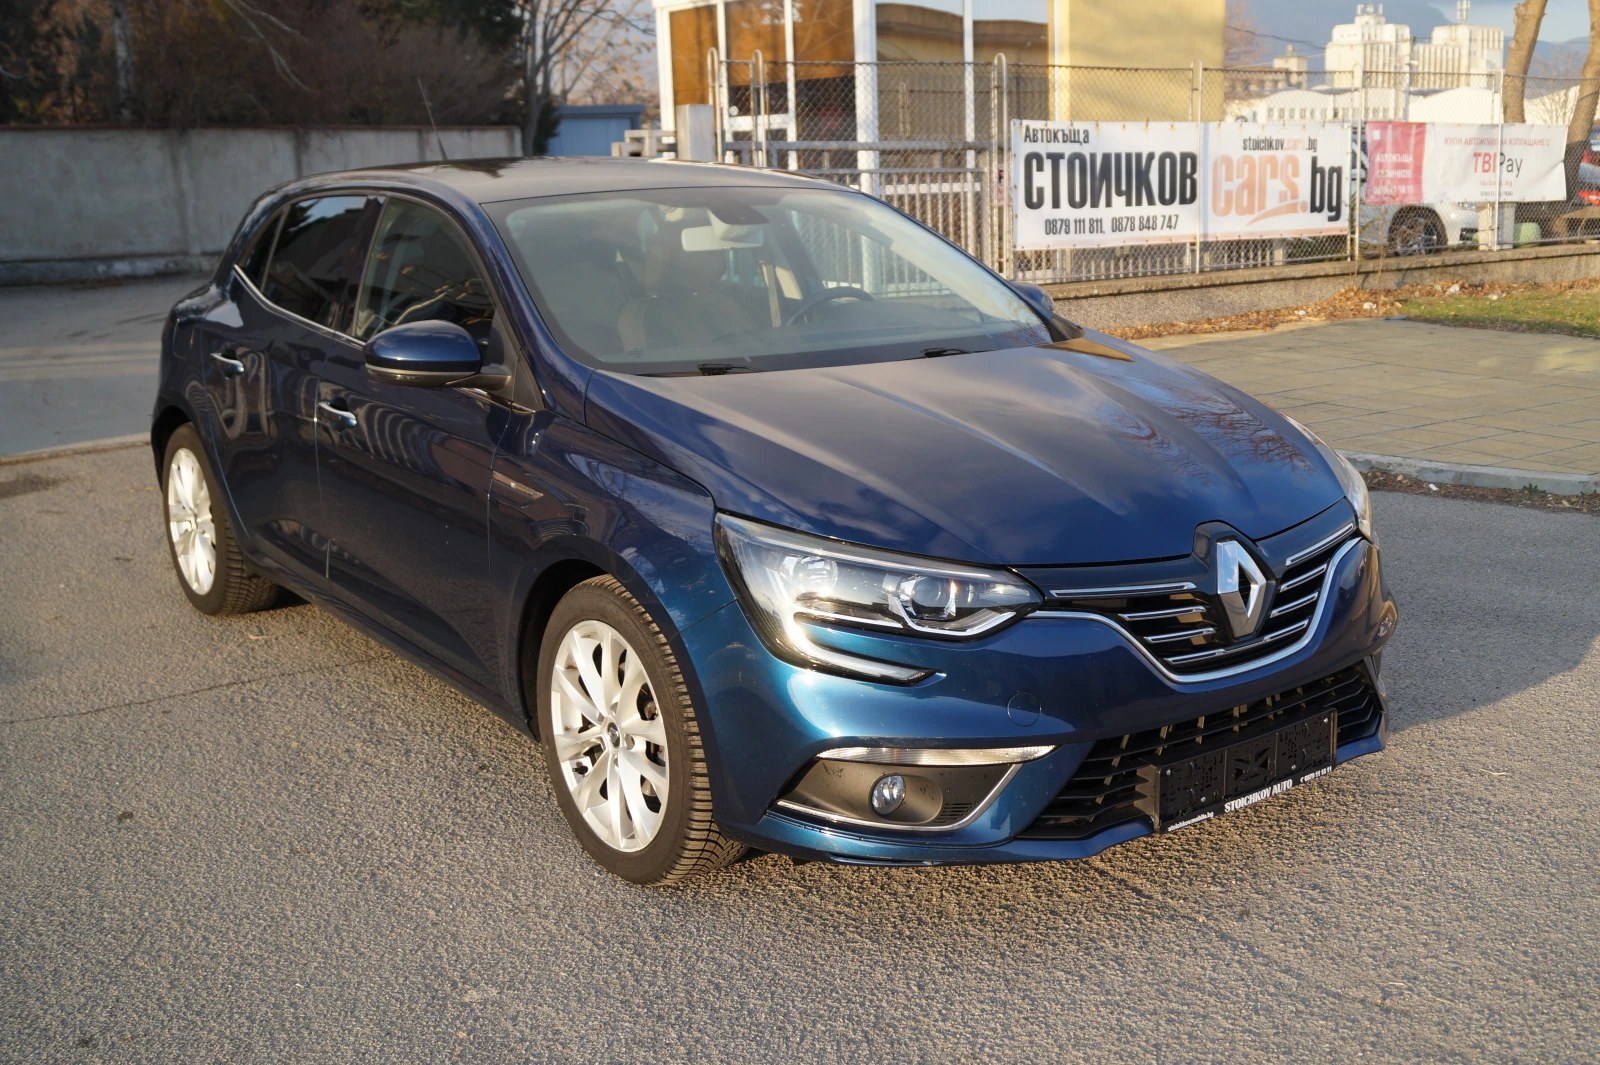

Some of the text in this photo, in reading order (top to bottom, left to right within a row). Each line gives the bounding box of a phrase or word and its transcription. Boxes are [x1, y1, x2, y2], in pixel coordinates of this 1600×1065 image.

[1444, 136, 1463, 146] КУПИ
[1375, 152, 1414, 163] АВТОКЪЩА
[1023, 151, 1198, 210] СТОИЧКОВ
[1211, 153, 1344, 223] cars.bg
[1044, 218, 1071, 235] 0879
[1074, 217, 1086, 234] 111
[1111, 215, 1136, 232] 0878
[1138, 215, 1158, 231] 848
[1160, 213, 1179, 230] 747
[1224, 786, 1272, 813] STOICHKOV
[1271, 779, 1293, 797] AUTO
